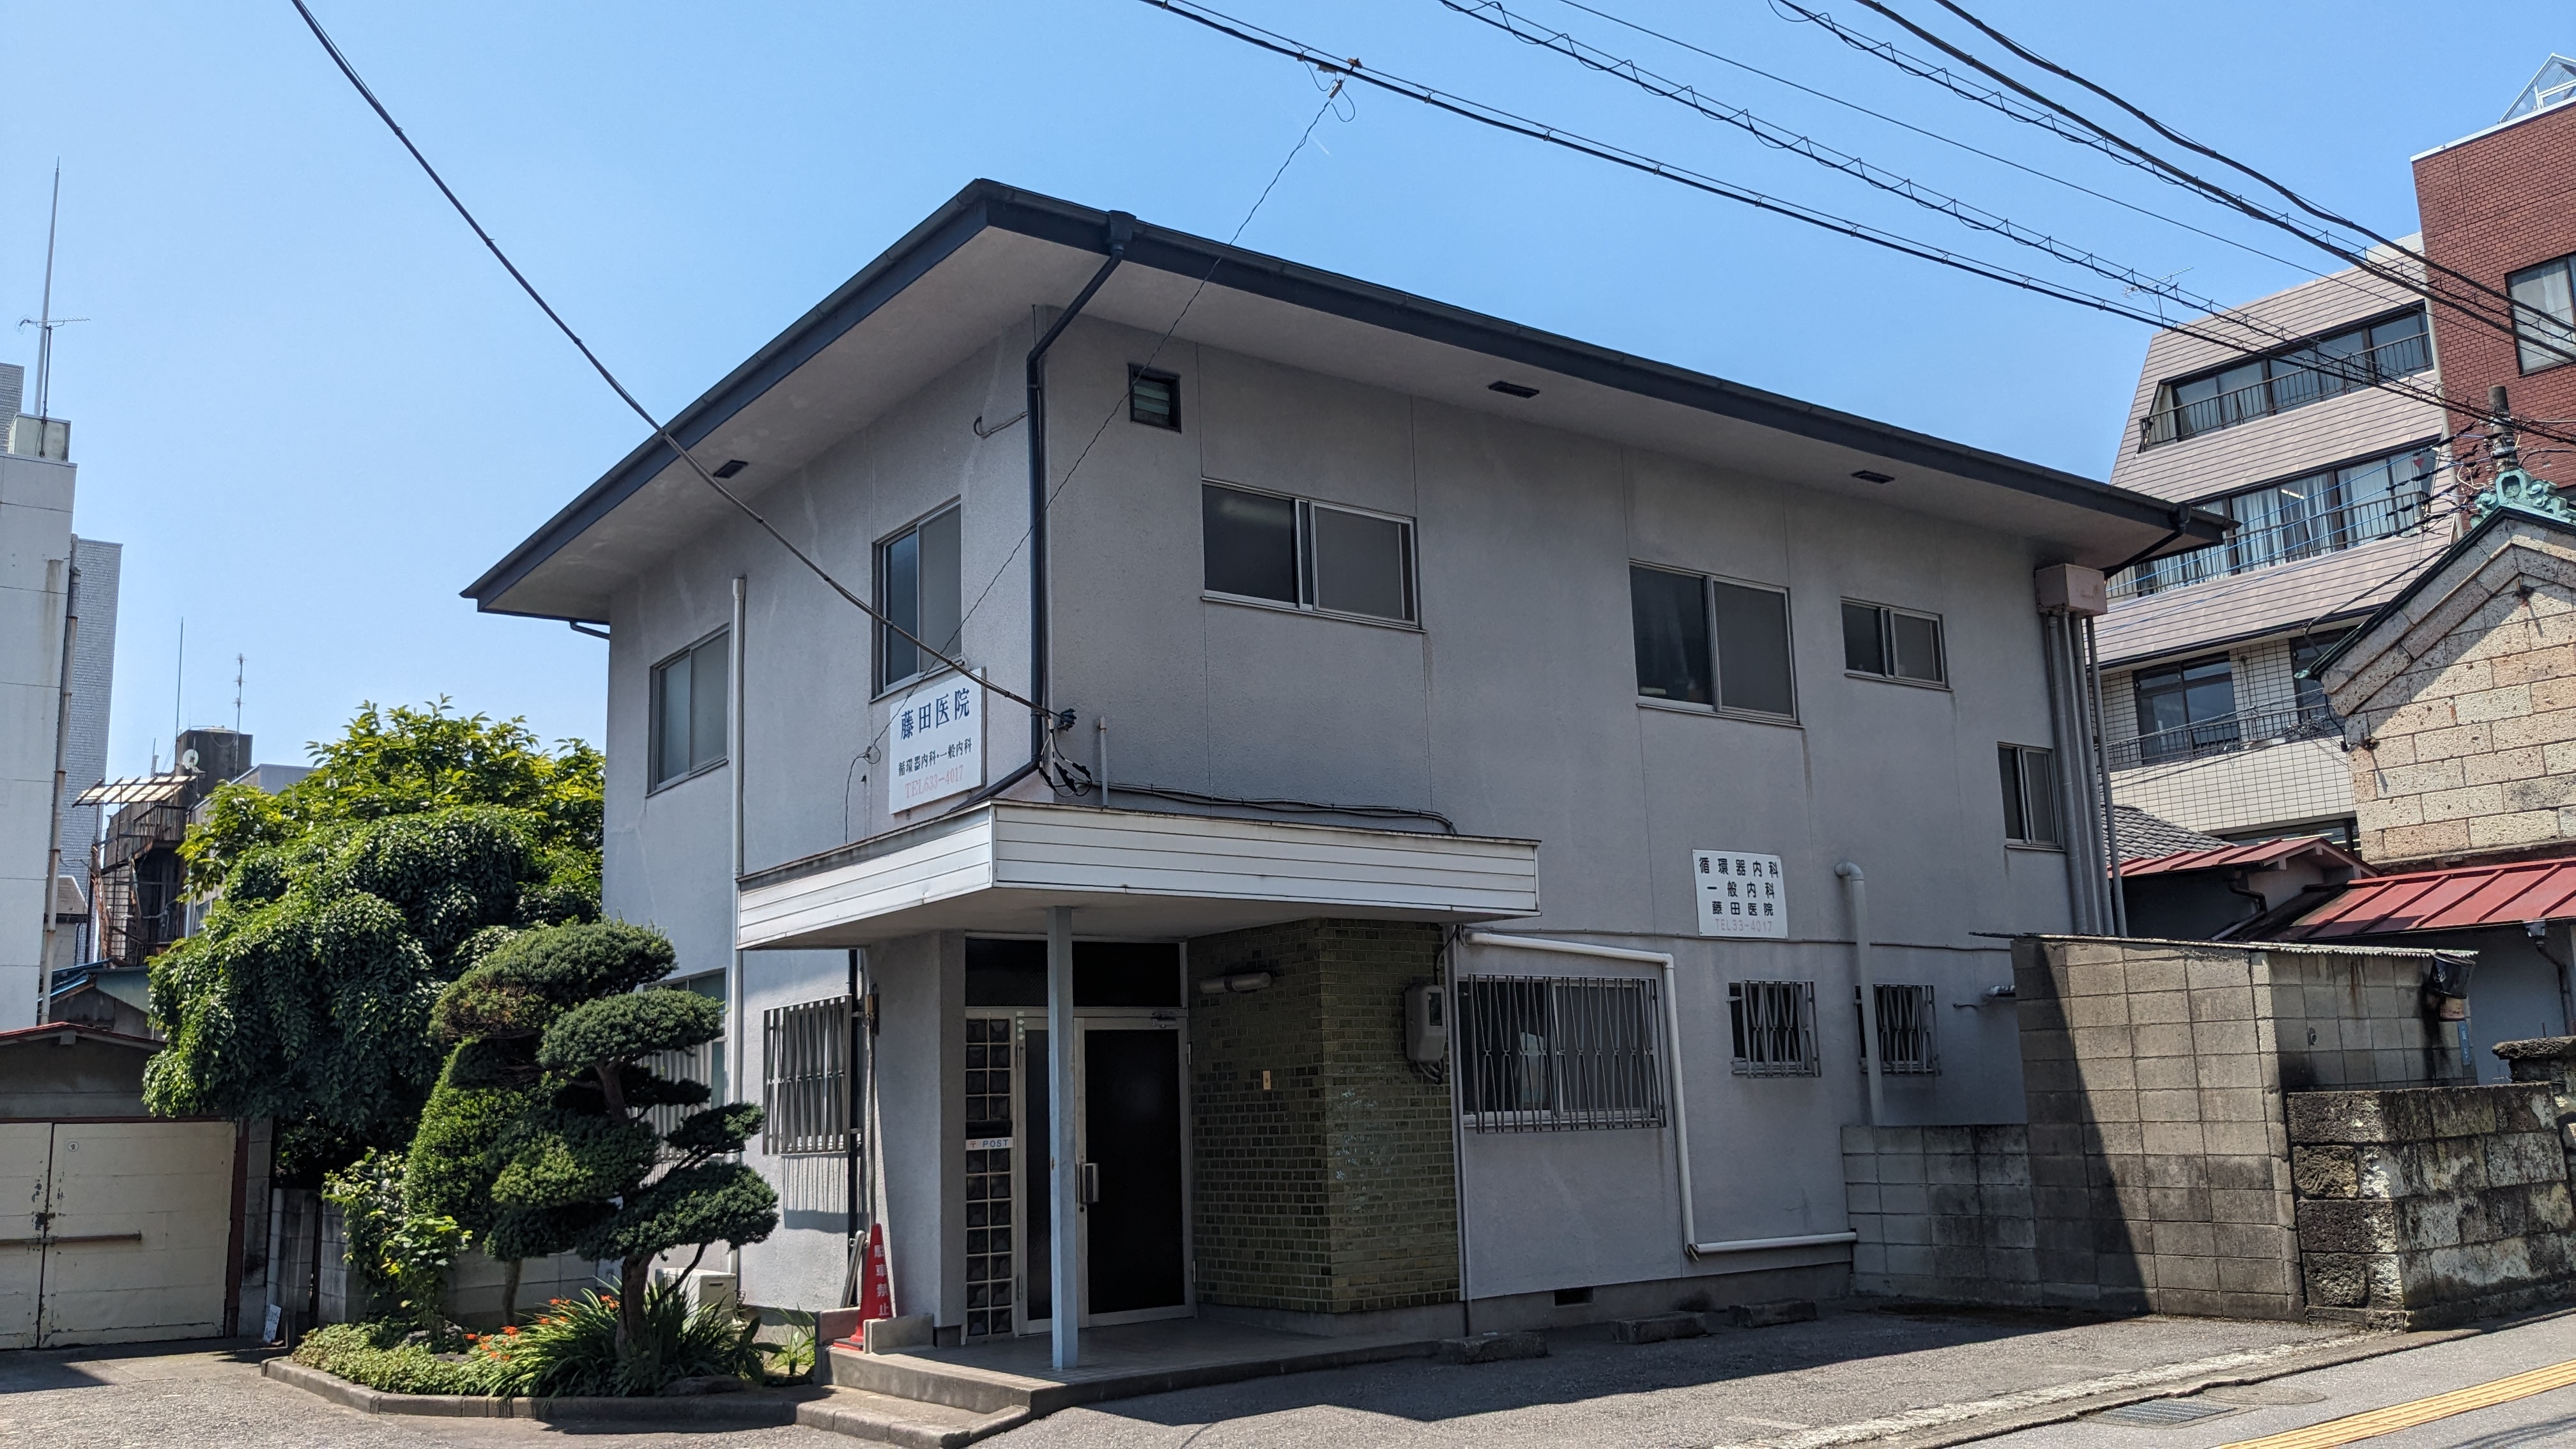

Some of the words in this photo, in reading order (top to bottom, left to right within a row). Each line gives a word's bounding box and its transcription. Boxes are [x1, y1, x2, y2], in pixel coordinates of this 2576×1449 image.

[901, 687, 970, 740] 藤田医院
[1699, 857, 1779, 878] 循環器内科
[1707, 880, 1775, 899] 一般内科
[1712, 900, 1774, 917] 藤田医院
[983, 1139, 1008, 1147] POST
